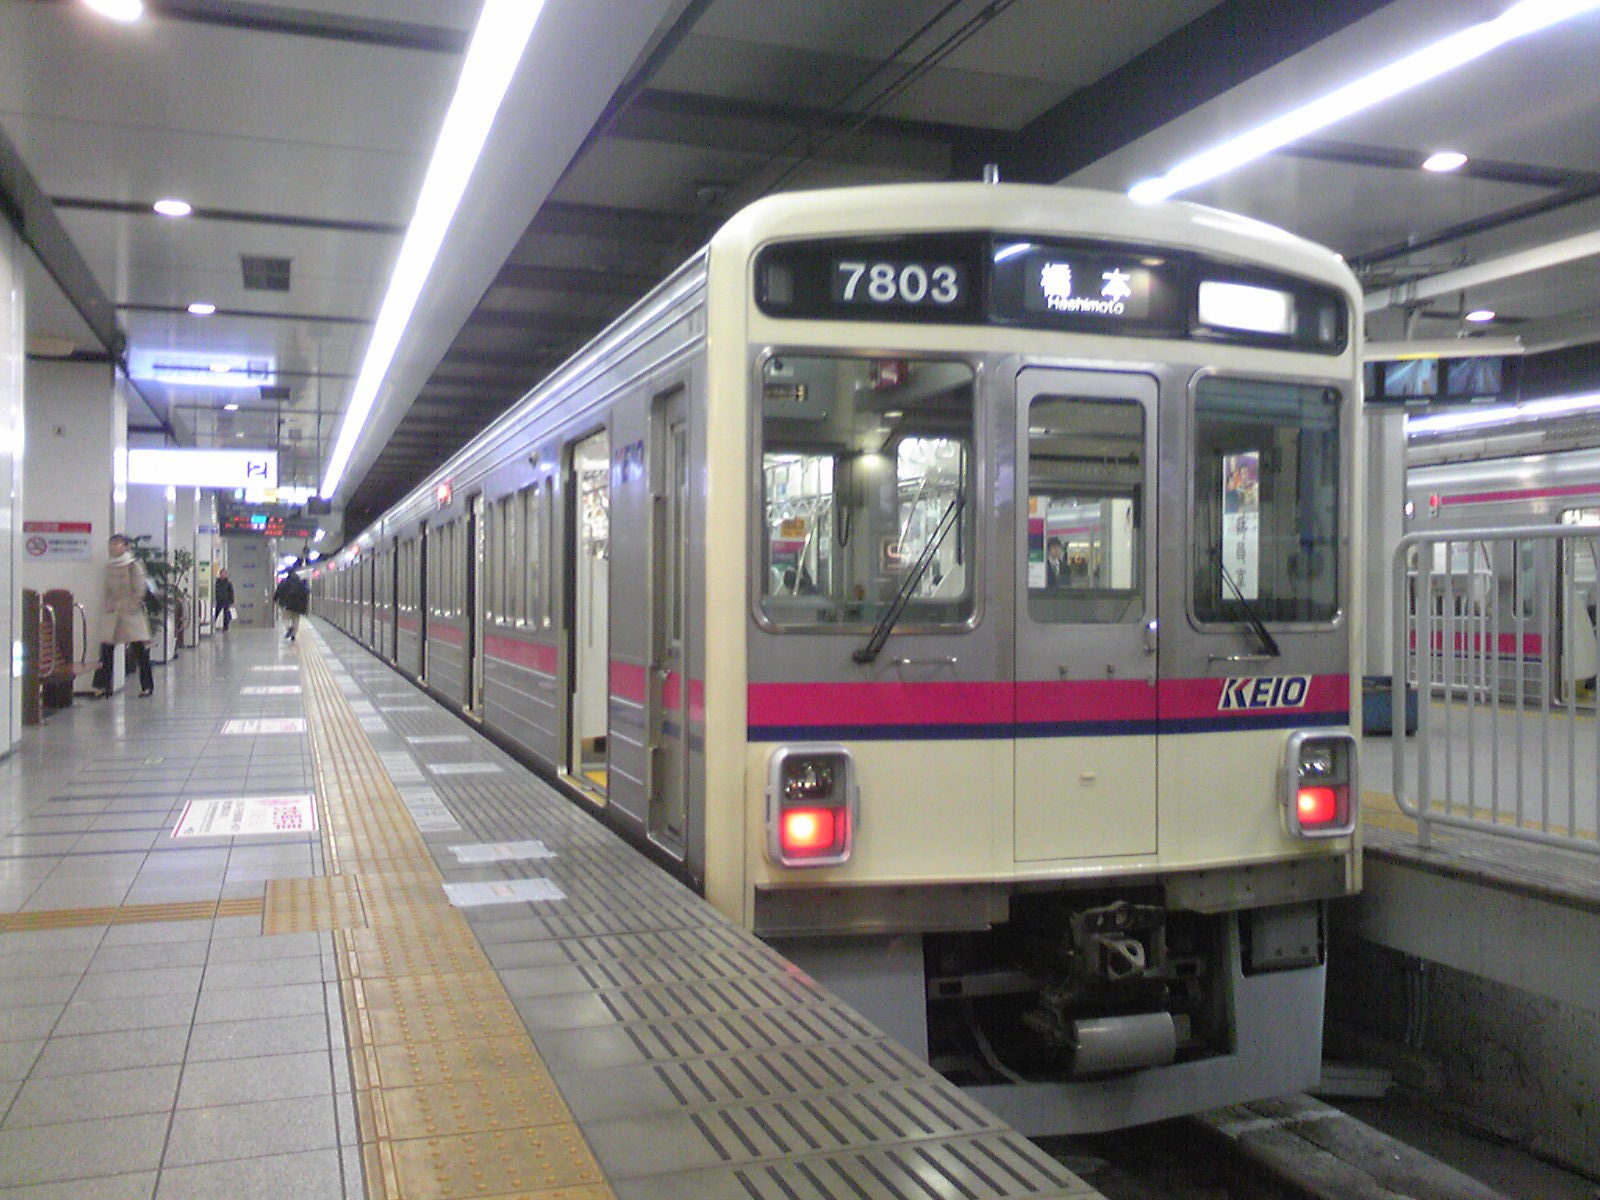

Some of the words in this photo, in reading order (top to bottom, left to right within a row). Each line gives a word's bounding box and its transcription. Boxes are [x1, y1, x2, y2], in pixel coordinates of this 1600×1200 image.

[838, 262, 959, 304] 7803
[1047, 295, 1125, 315] Hashimoto
[1218, 676, 1311, 709] KEIO
